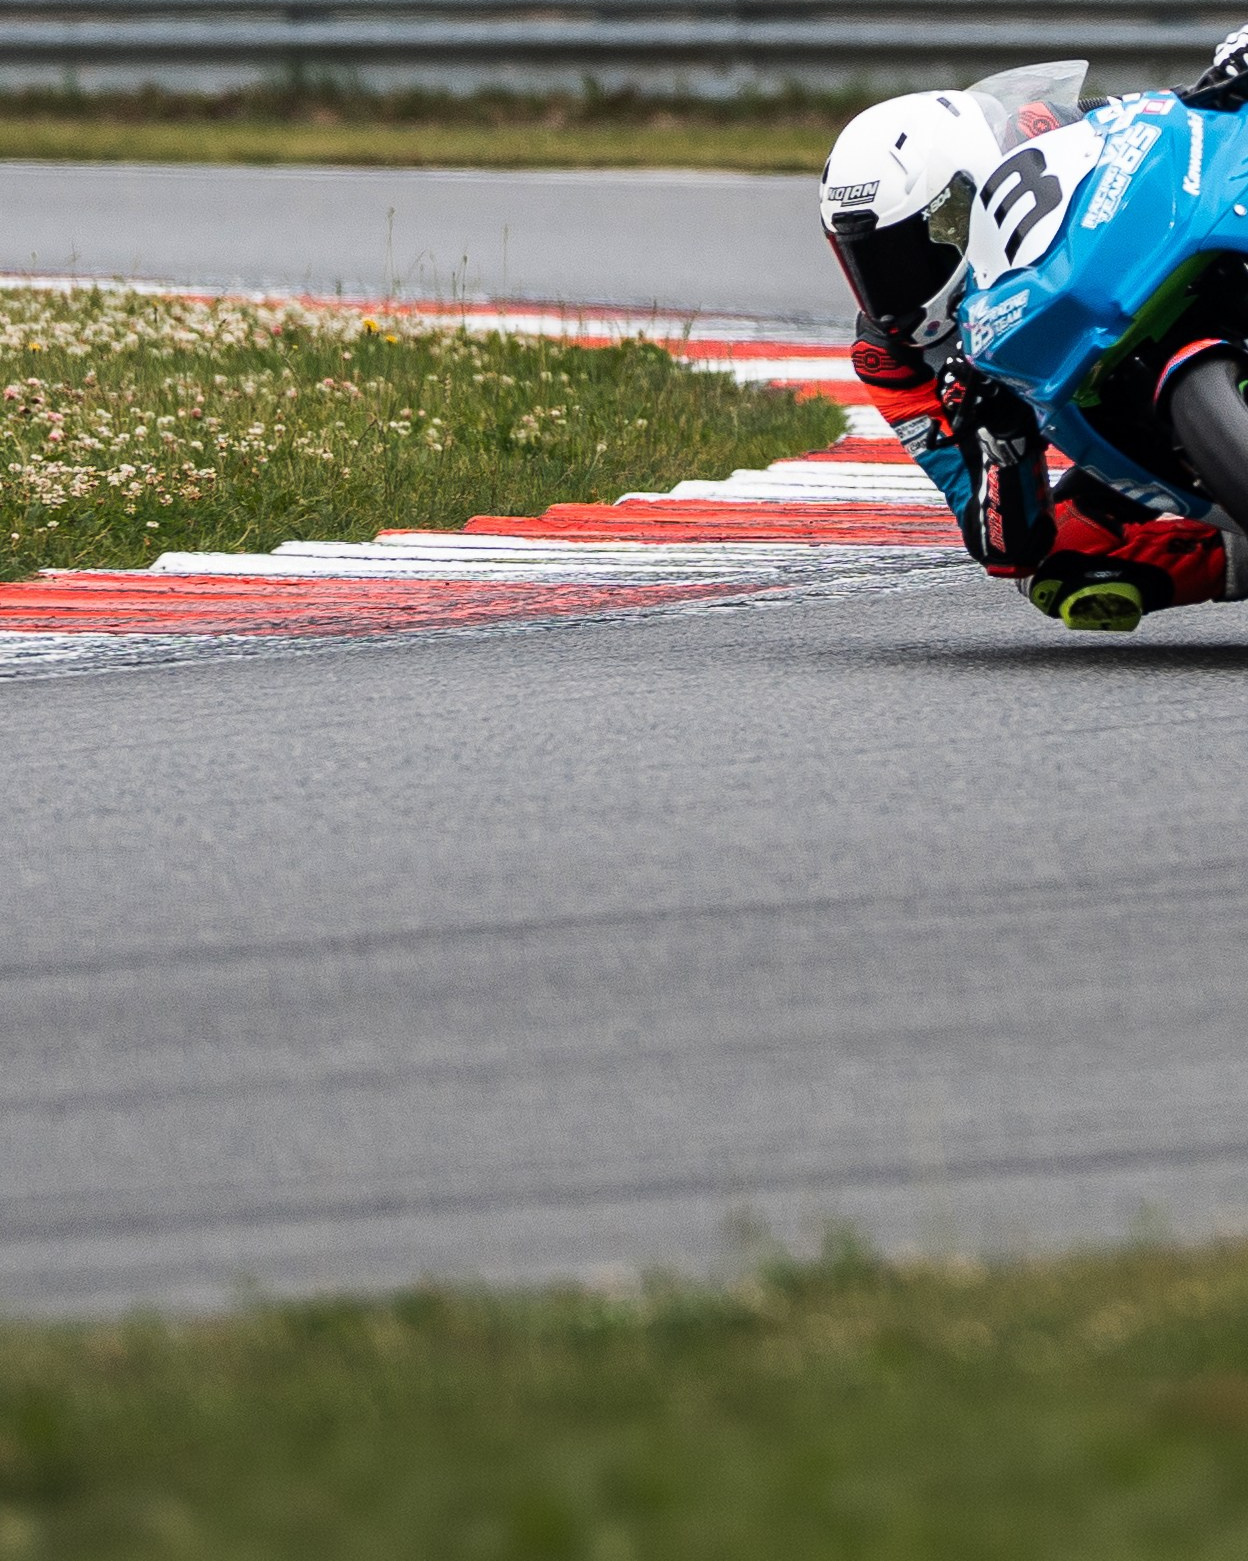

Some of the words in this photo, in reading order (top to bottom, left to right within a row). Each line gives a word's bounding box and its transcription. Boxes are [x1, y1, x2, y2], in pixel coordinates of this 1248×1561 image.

[1113, 121, 1162, 175] 65
[1182, 109, 1204, 196] Kawasaki
[827, 180, 880, 207] NOLAN
[980, 147, 1063, 266] 3
[1097, 171, 1132, 223] TEAM
